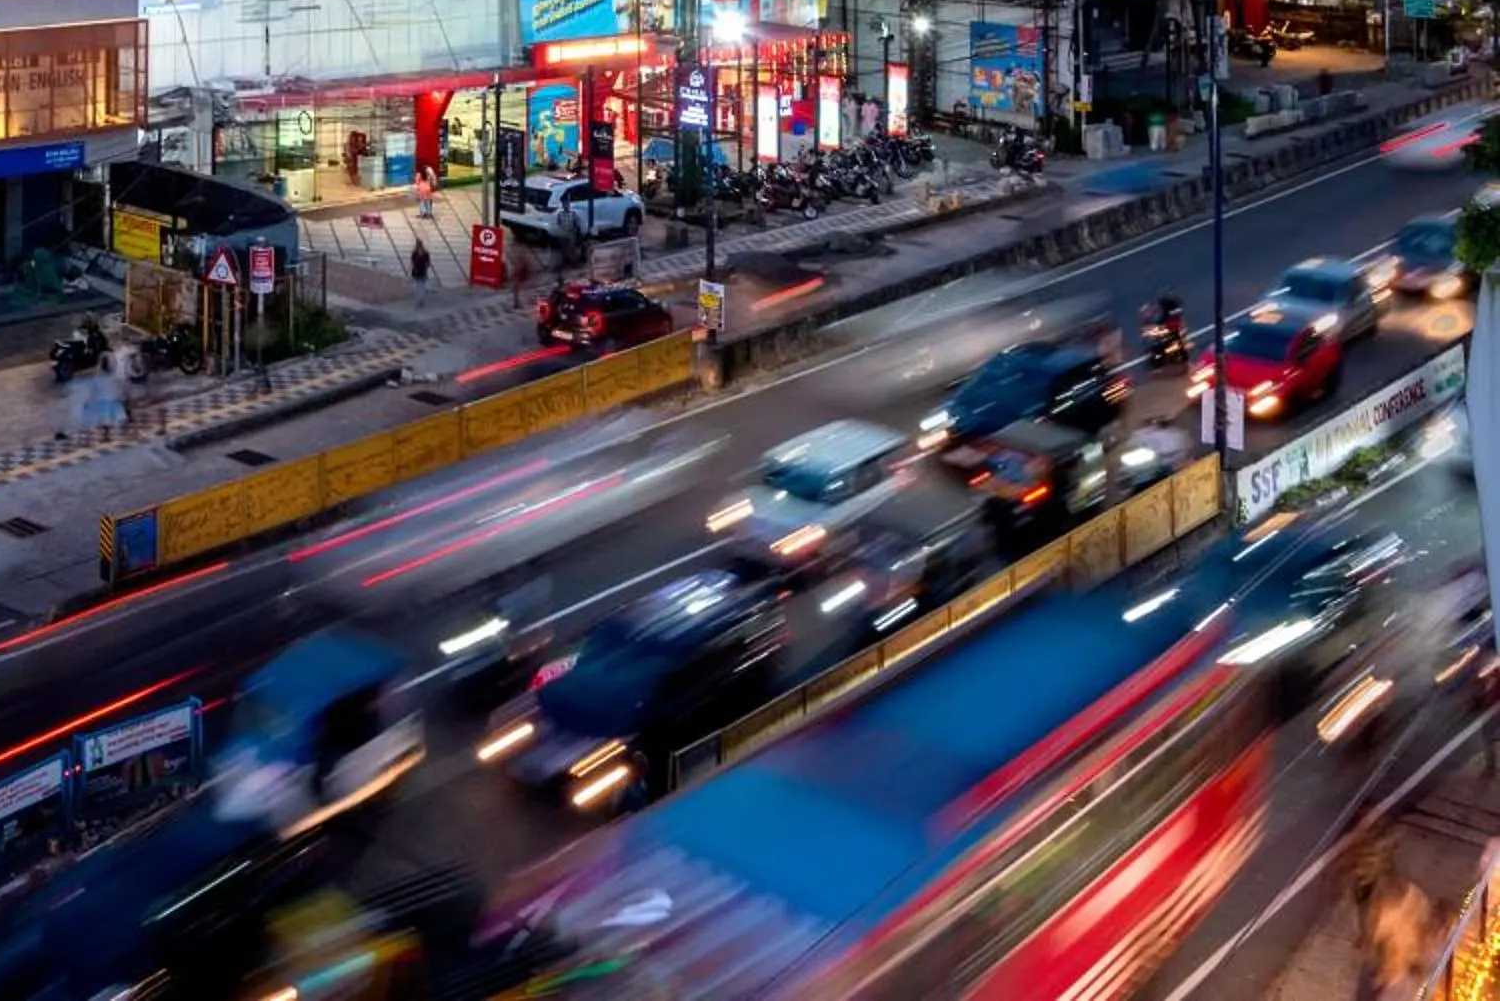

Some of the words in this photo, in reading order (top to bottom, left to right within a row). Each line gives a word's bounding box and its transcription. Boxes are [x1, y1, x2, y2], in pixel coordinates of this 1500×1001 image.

[483, 231, 493, 243] P
[1251, 458, 1282, 504] SSF
[1373, 378, 1427, 427] CONFERENCE
